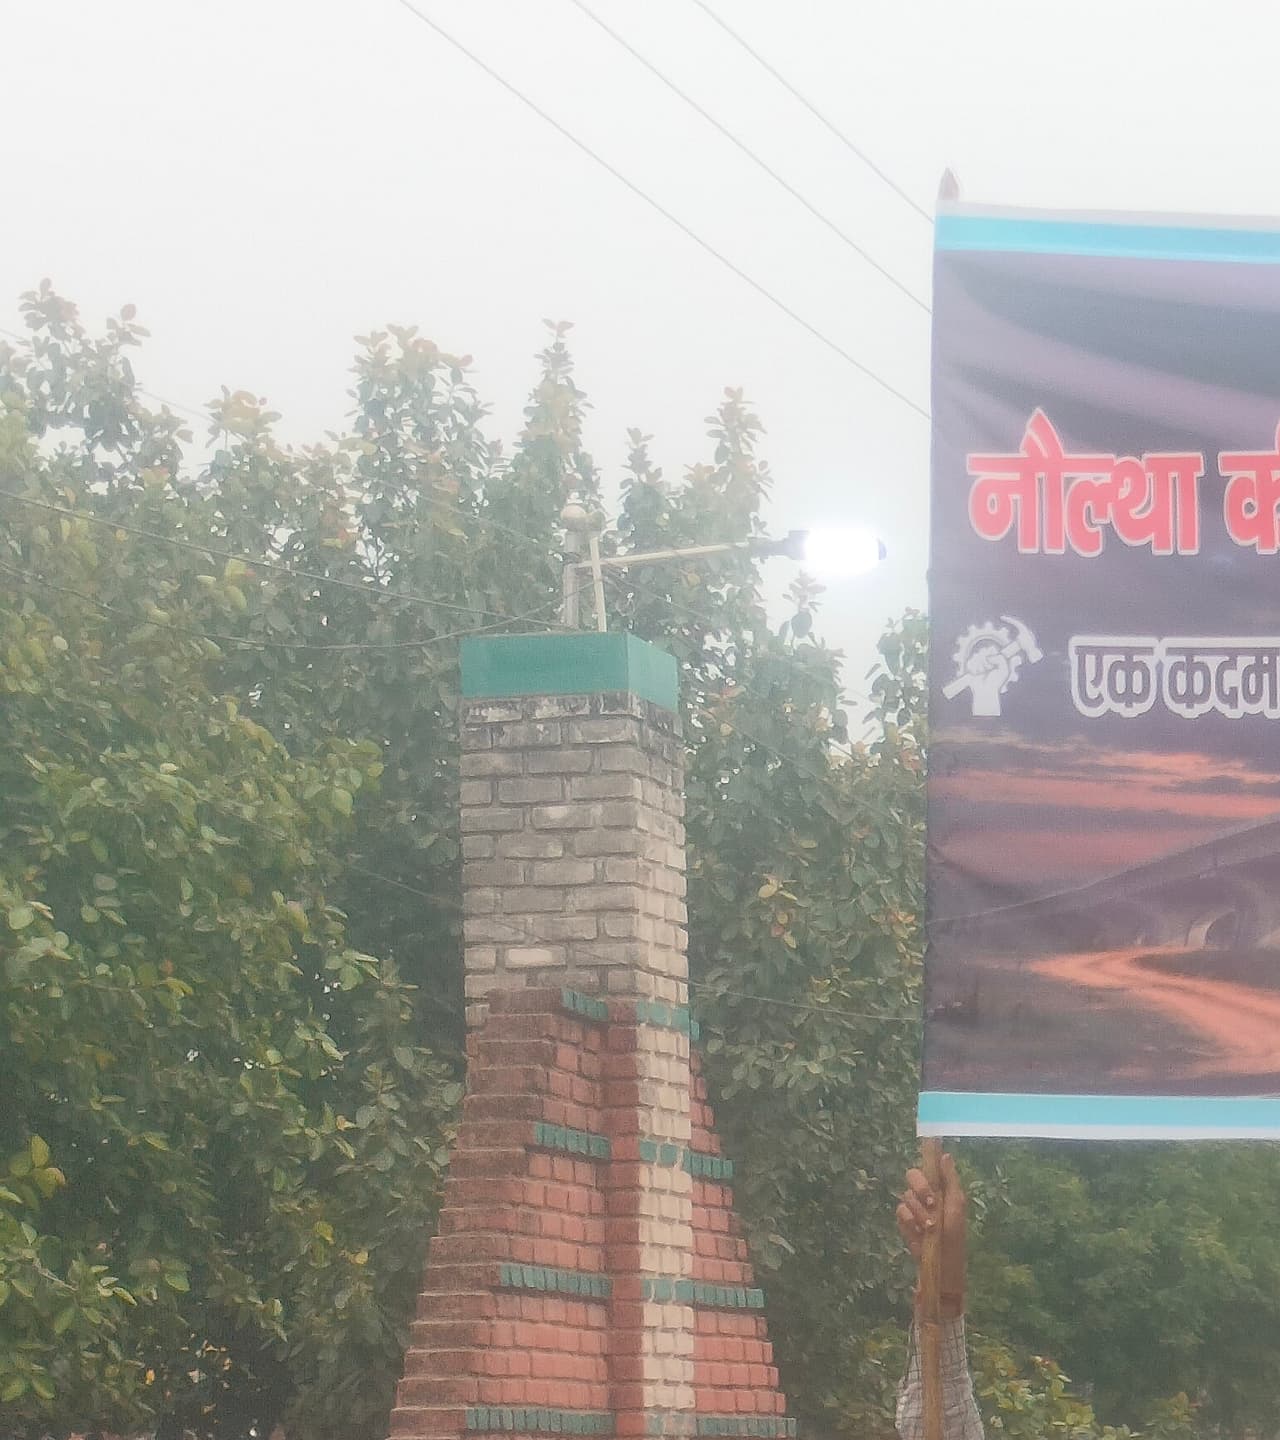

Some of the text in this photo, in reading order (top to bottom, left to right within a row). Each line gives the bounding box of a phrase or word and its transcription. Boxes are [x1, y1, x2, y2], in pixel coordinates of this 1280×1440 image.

[968, 411, 1204, 554] नौल्था
[1074, 638, 1154, 714] एक
[1165, 638, 1280, 711] कदम
